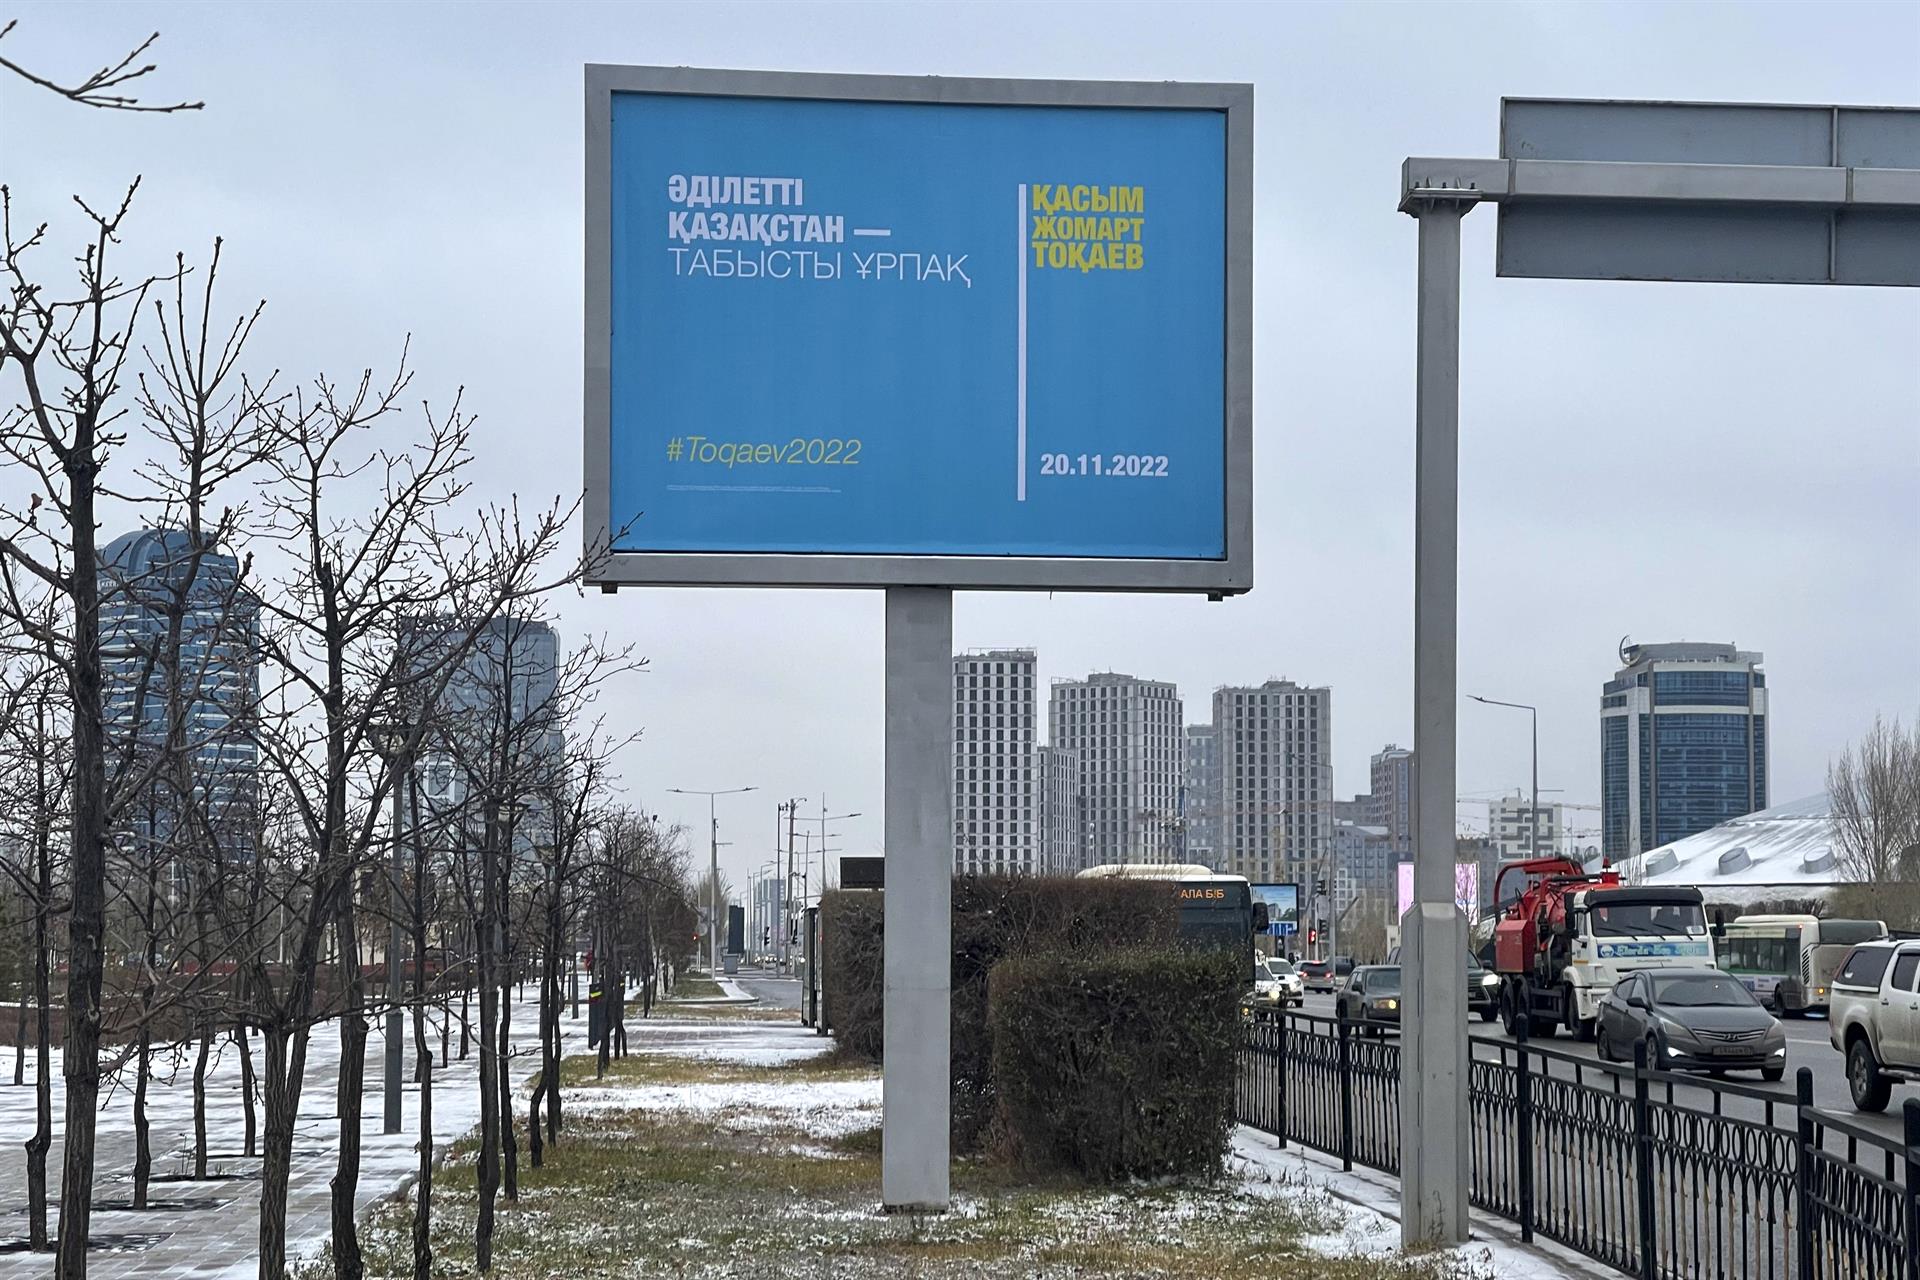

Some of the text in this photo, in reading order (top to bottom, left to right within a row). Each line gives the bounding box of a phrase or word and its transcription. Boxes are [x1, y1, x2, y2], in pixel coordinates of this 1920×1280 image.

[668, 174, 804, 209] ӘДІЛЕТТІ
[1031, 184, 1145, 216] ҚАСЫМ
[668, 211, 844, 247] ҚАЗАҚСТАН
[1031, 215, 1145, 243] ЖОМАРТ
[667, 247, 972, 289] ТАБЫСТЫ ҰРПАҚ
[1031, 241, 1145, 274] ТОҚАЕВ
[667, 436, 863, 470] #Toqaev2022
[1040, 453, 1169, 477] 20.11.2022
